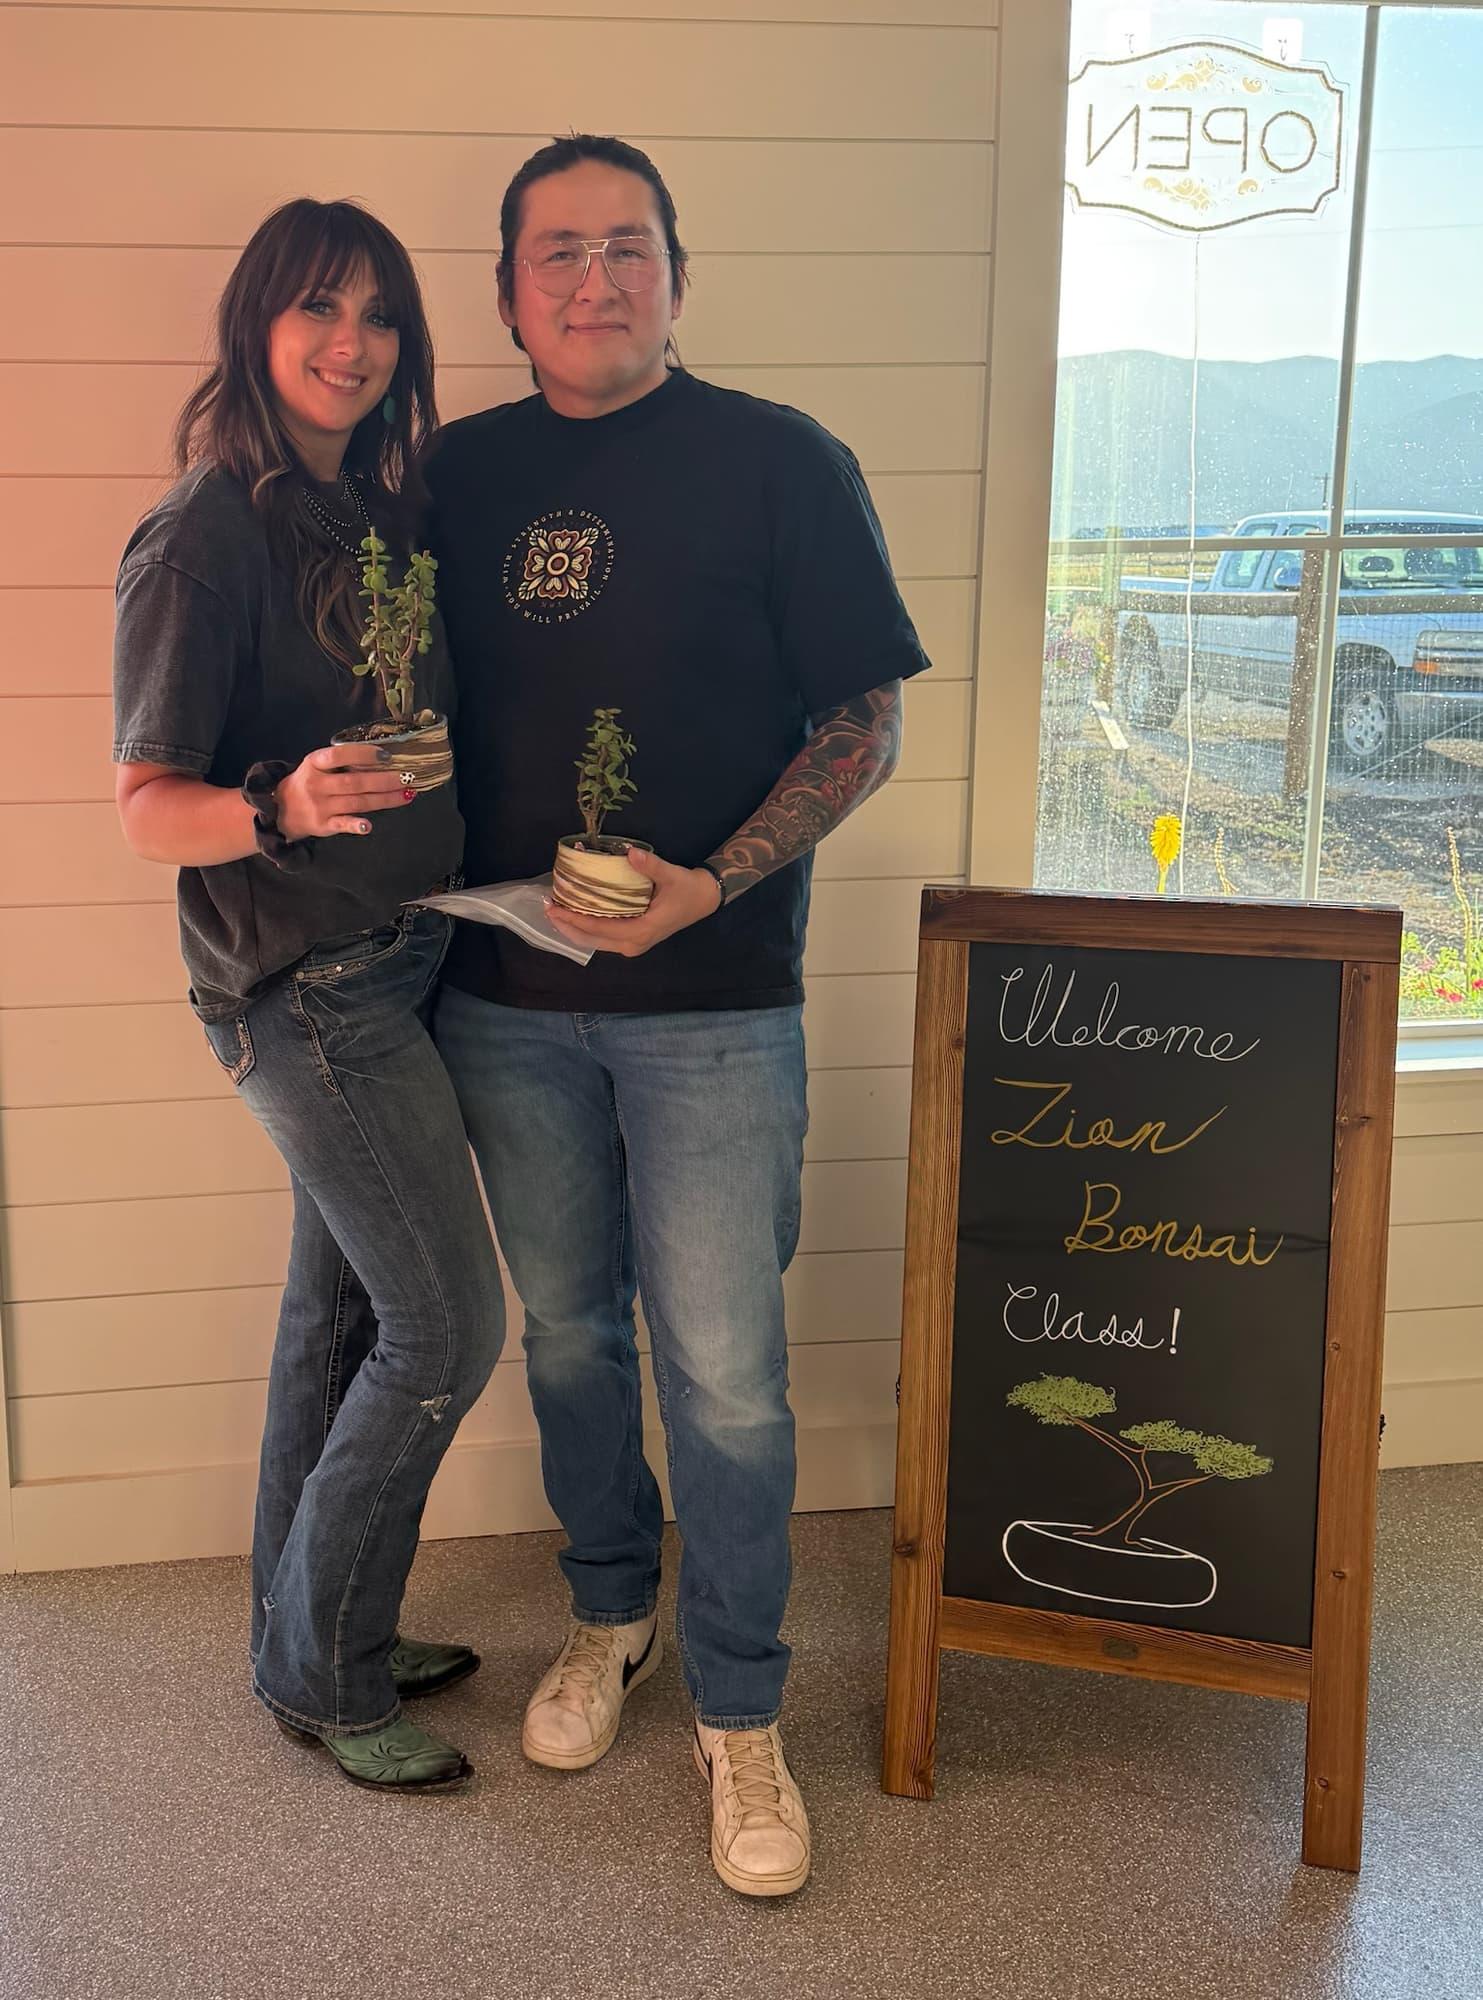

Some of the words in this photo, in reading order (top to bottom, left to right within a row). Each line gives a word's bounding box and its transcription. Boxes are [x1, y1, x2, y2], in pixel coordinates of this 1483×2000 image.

[503, 554, 513, 583] WITH
[511, 510, 562, 549] STRENGTH
[579, 510, 614, 581] DETERMINATION
[505, 591, 521, 610] YOU
[523, 609, 551, 624] WILL
[558, 589, 601, 623] PREVAIL
[999, 963, 1261, 1061] Welcome
[990, 1077, 1229, 1154] Zion
[1063, 1180, 1285, 1266] Bonsai
[1003, 1282, 1182, 1355] Class!
